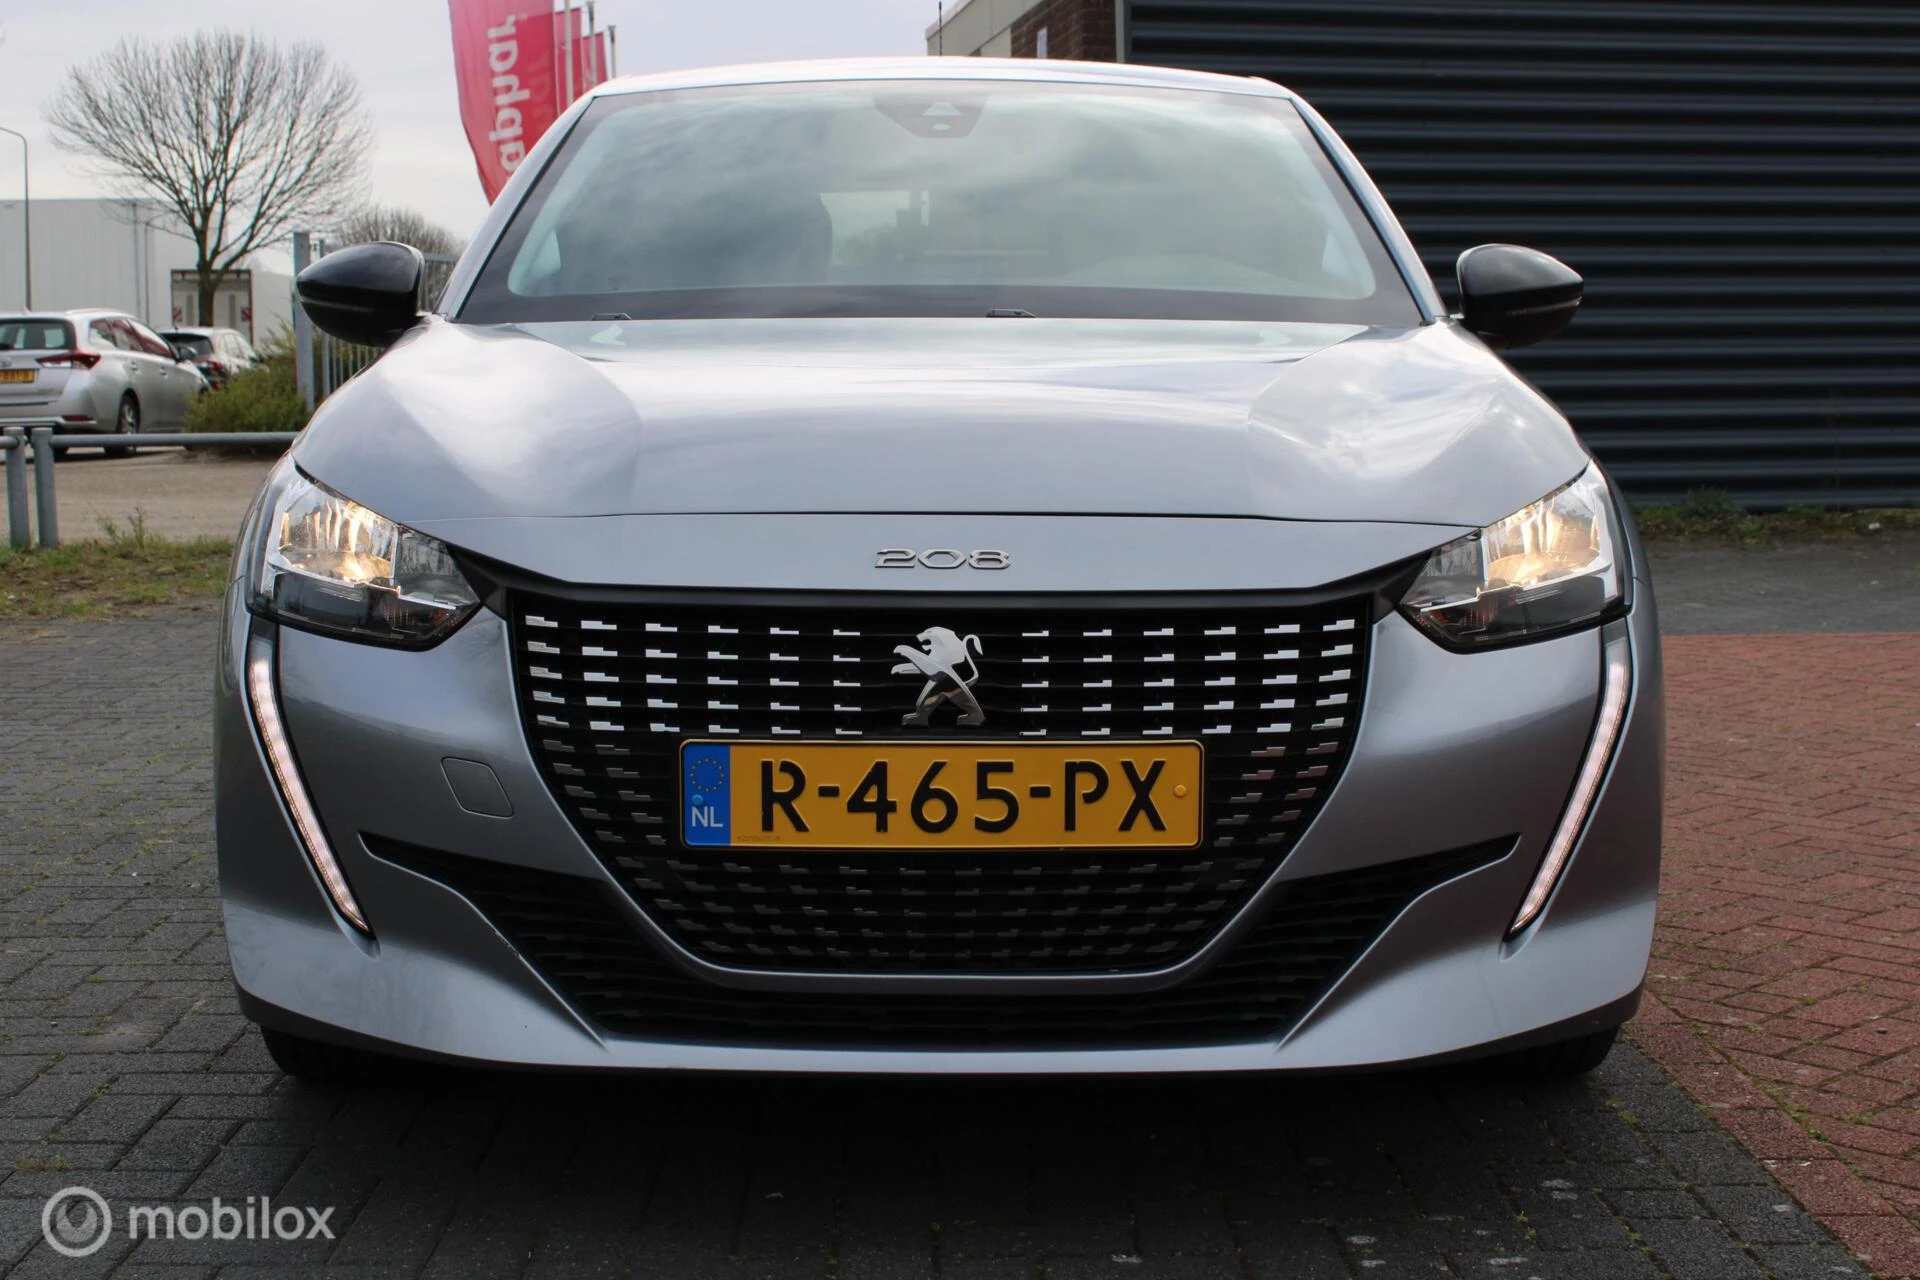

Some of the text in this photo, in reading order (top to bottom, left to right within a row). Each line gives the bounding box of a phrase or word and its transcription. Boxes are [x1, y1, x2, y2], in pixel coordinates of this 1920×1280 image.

[874, 548, 1011, 570] 208
[759, 758, 1167, 834] R-465-PX
[690, 805, 724, 829] NL
